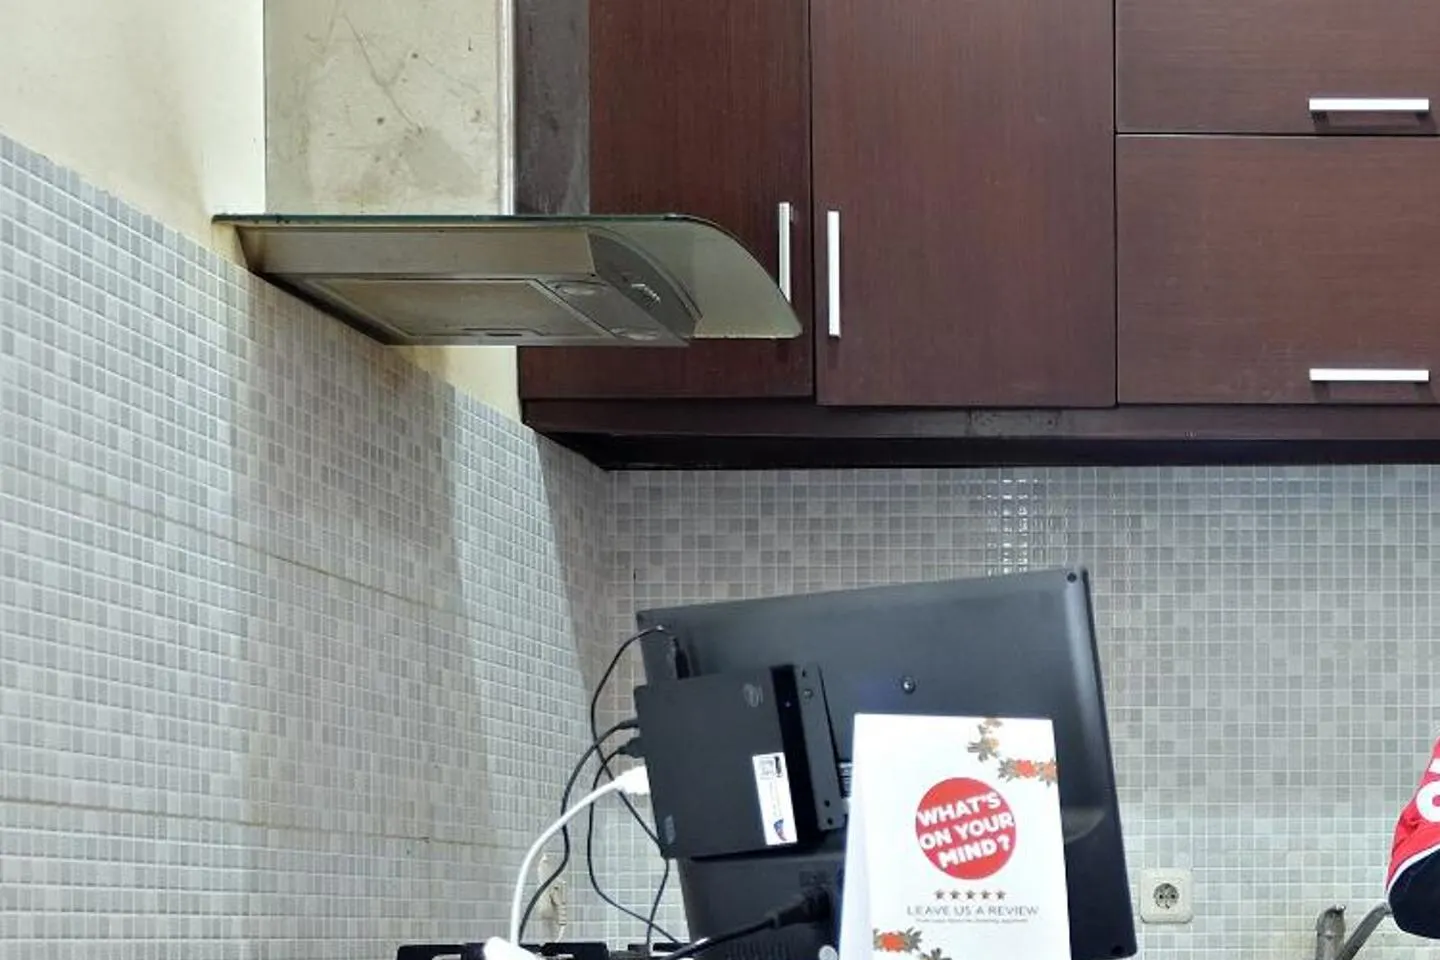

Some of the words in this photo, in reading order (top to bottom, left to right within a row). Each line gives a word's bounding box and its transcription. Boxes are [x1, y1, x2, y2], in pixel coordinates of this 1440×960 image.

[917, 791, 1001, 827] WHAT'S
[920, 829, 953, 850] ON
[954, 811, 1015, 841] YOUR
[906, 905, 949, 917] LEAVE
[953, 905, 972, 917] US
[976, 905, 986, 917] A
[988, 905, 1039, 917] REVIEW
